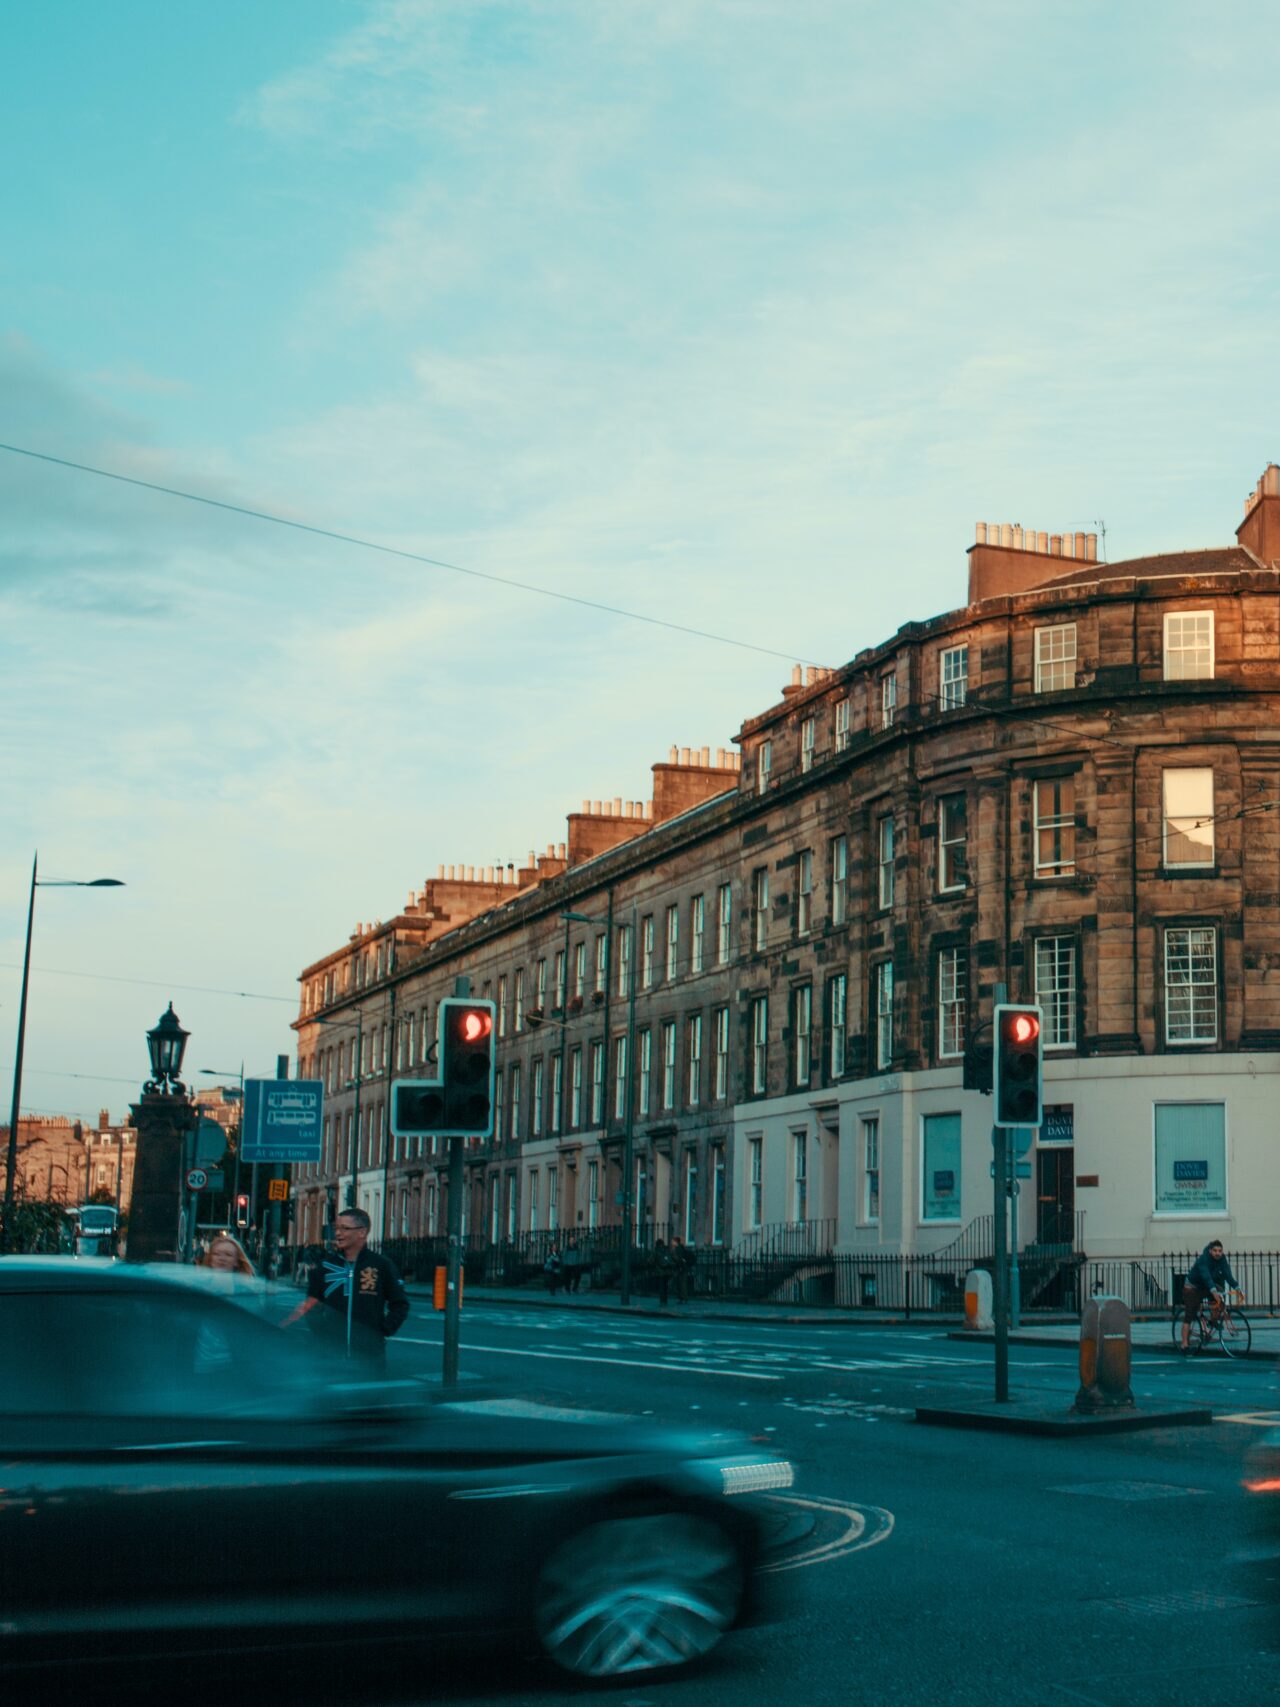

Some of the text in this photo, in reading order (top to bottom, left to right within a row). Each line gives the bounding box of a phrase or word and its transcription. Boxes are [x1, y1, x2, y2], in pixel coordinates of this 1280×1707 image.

[299, 1129, 316, 1138] taxi
[256, 1149, 308, 1159] At any time
[189, 1174, 205, 1184] 20
